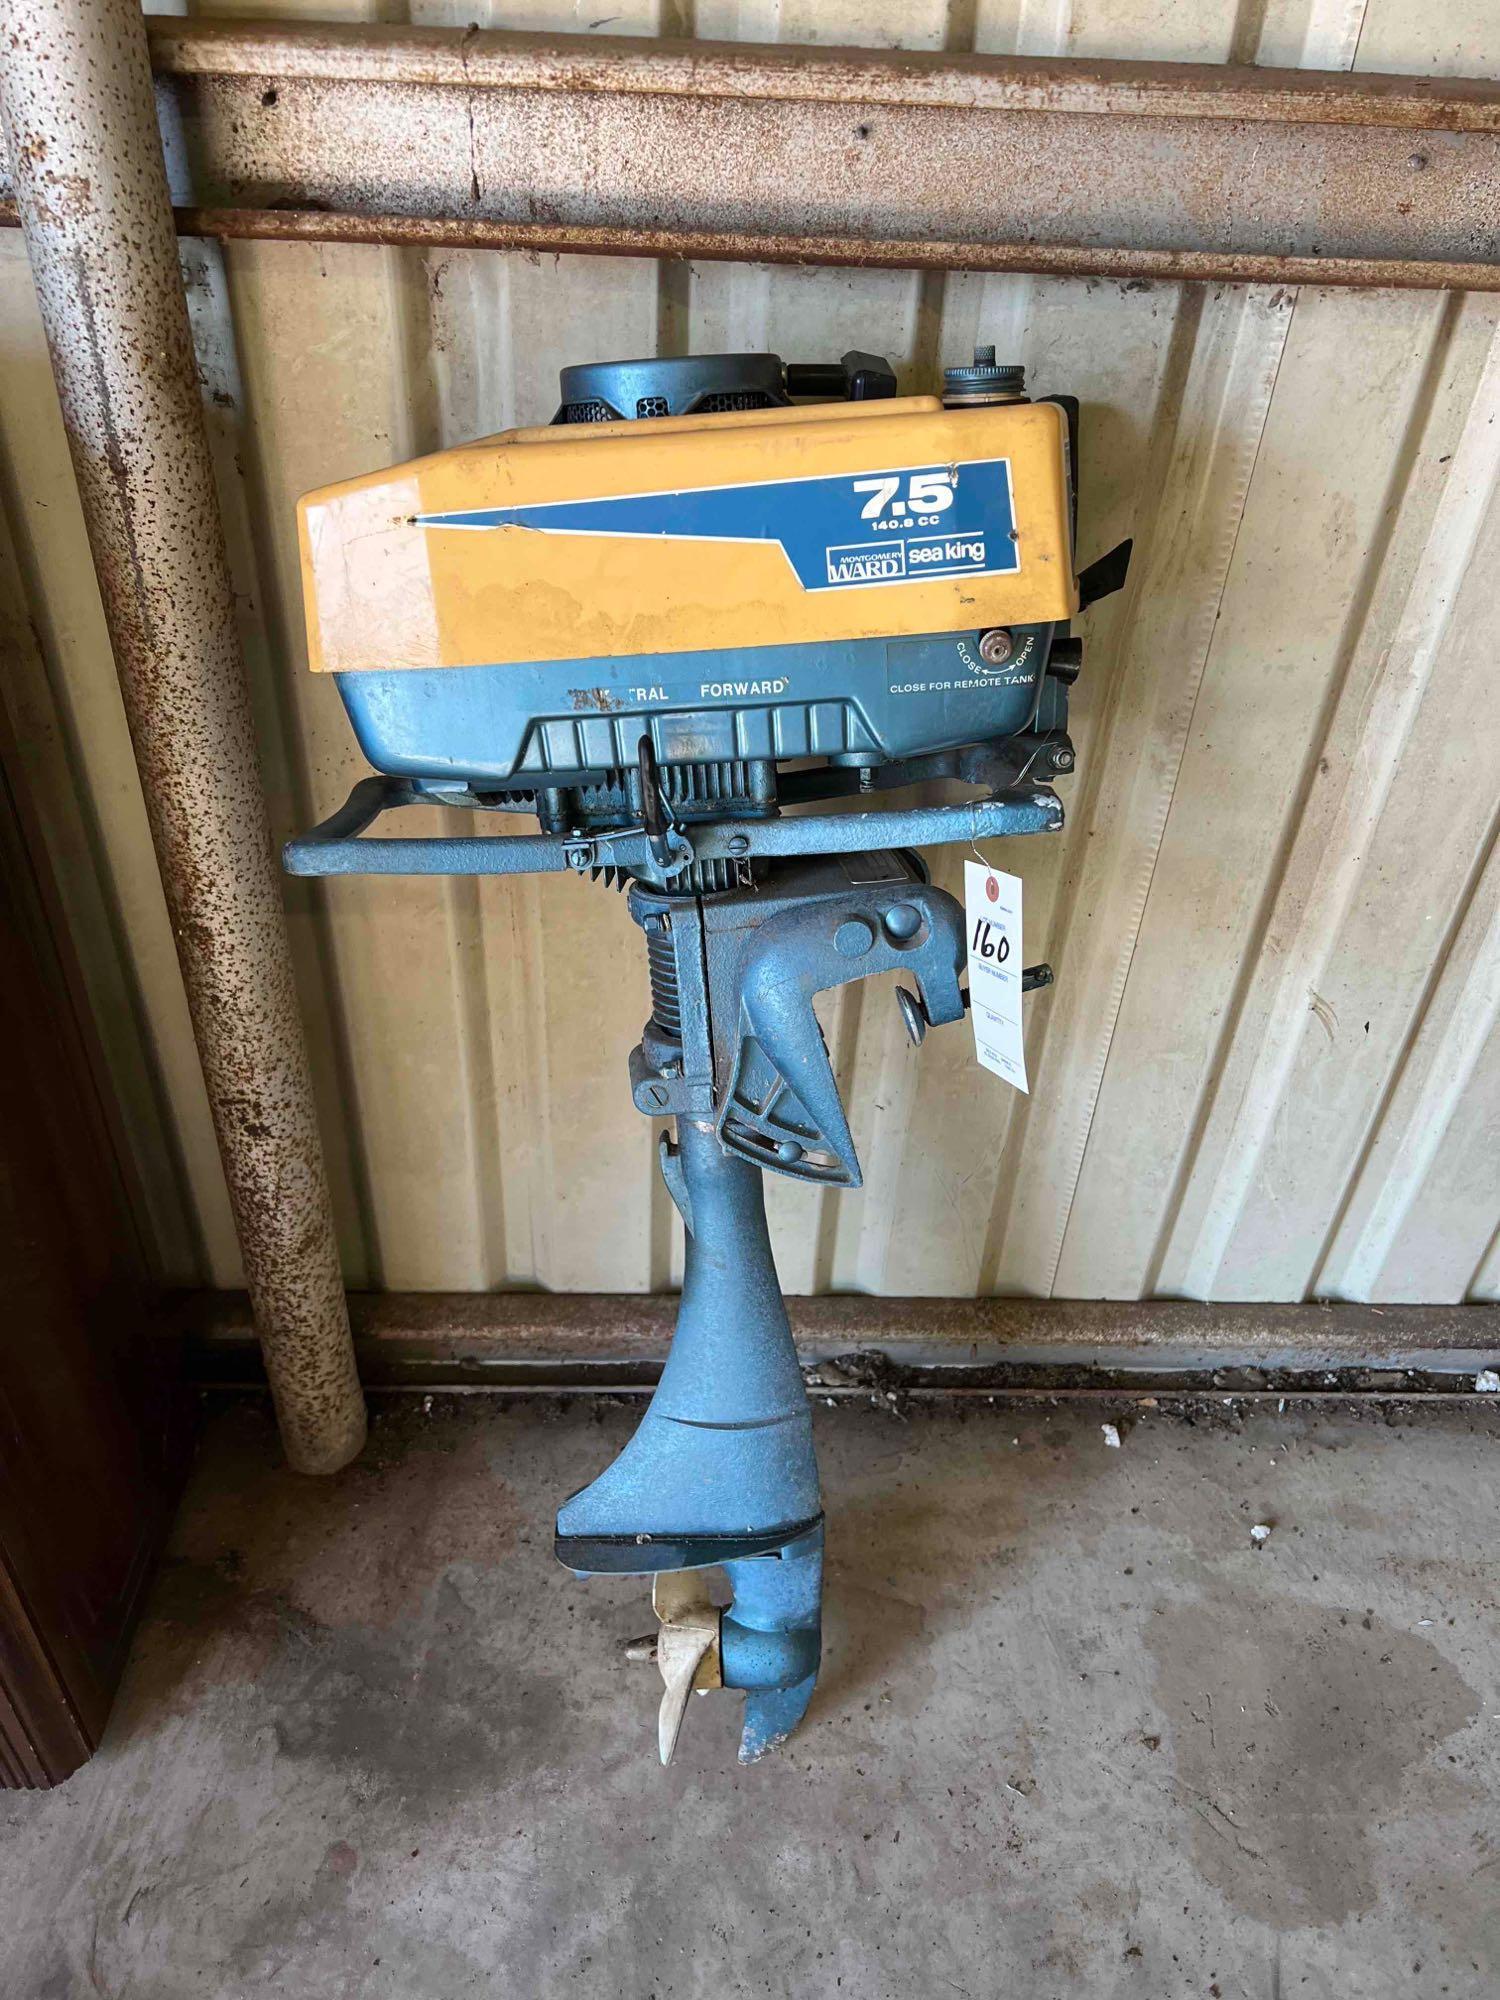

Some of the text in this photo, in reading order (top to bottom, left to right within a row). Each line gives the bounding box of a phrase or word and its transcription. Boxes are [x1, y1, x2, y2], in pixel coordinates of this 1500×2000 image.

[853, 472, 954, 519] 7.5
[918, 514, 940, 526] CC
[840, 551, 904, 564] MONTGOMERY
[909, 541, 985, 564] sea king
[830, 559, 898, 580] WARD
[956, 642, 982, 674] CLOSE
[1015, 636, 1035, 666] OPEN
[700, 681, 785, 698] FORWARD
[890, 673, 1035, 694] CLOSE FOR REMOTE TANK
[972, 918, 1010, 963] 160
